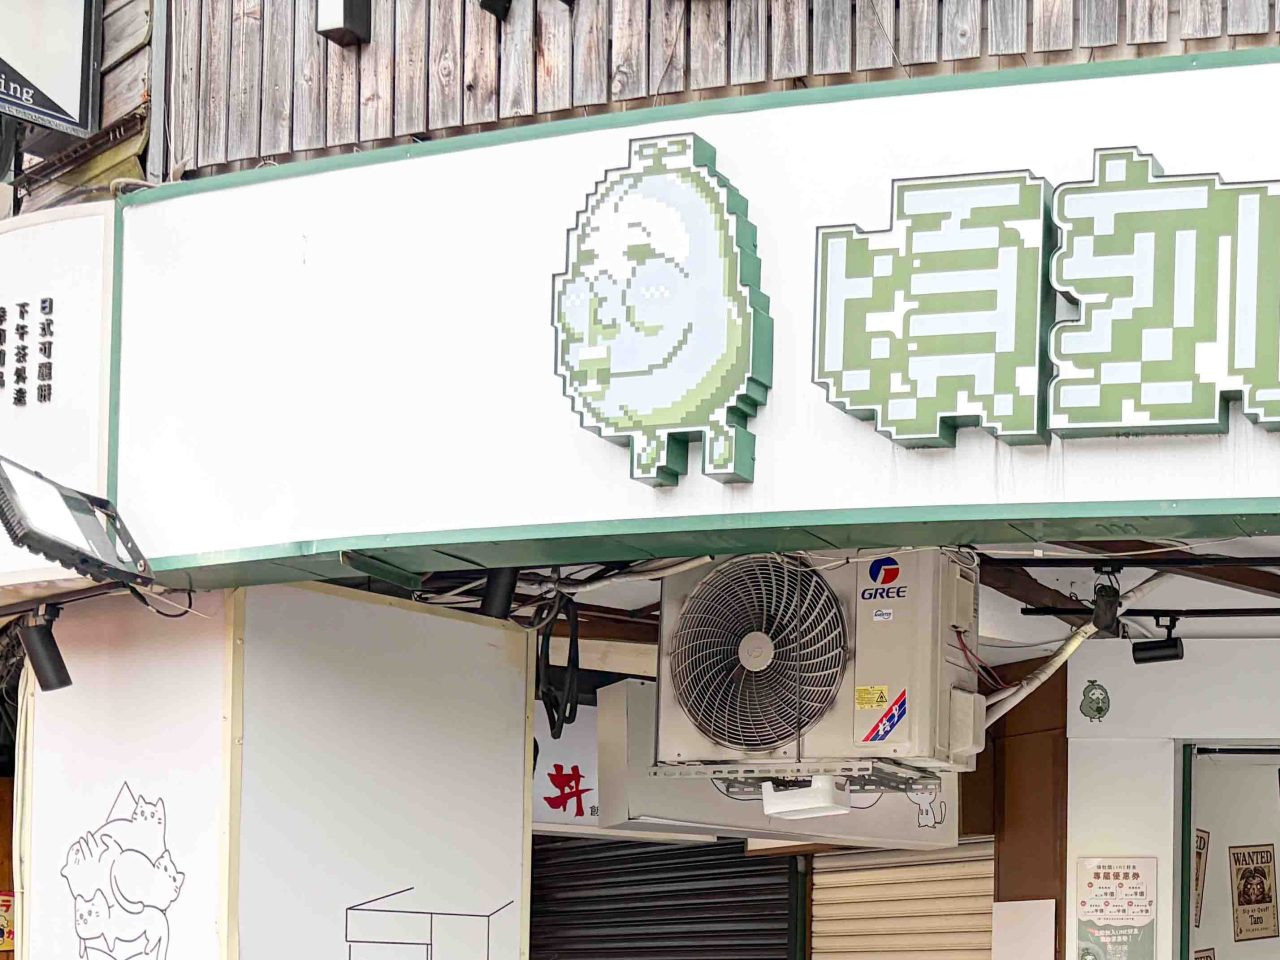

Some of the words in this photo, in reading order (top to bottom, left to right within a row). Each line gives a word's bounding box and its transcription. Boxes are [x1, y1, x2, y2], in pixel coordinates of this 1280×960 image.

[861, 586, 907, 600] GREE
[1232, 850, 1273, 866] WANTED
[1249, 914, 1264, 926] Taro
